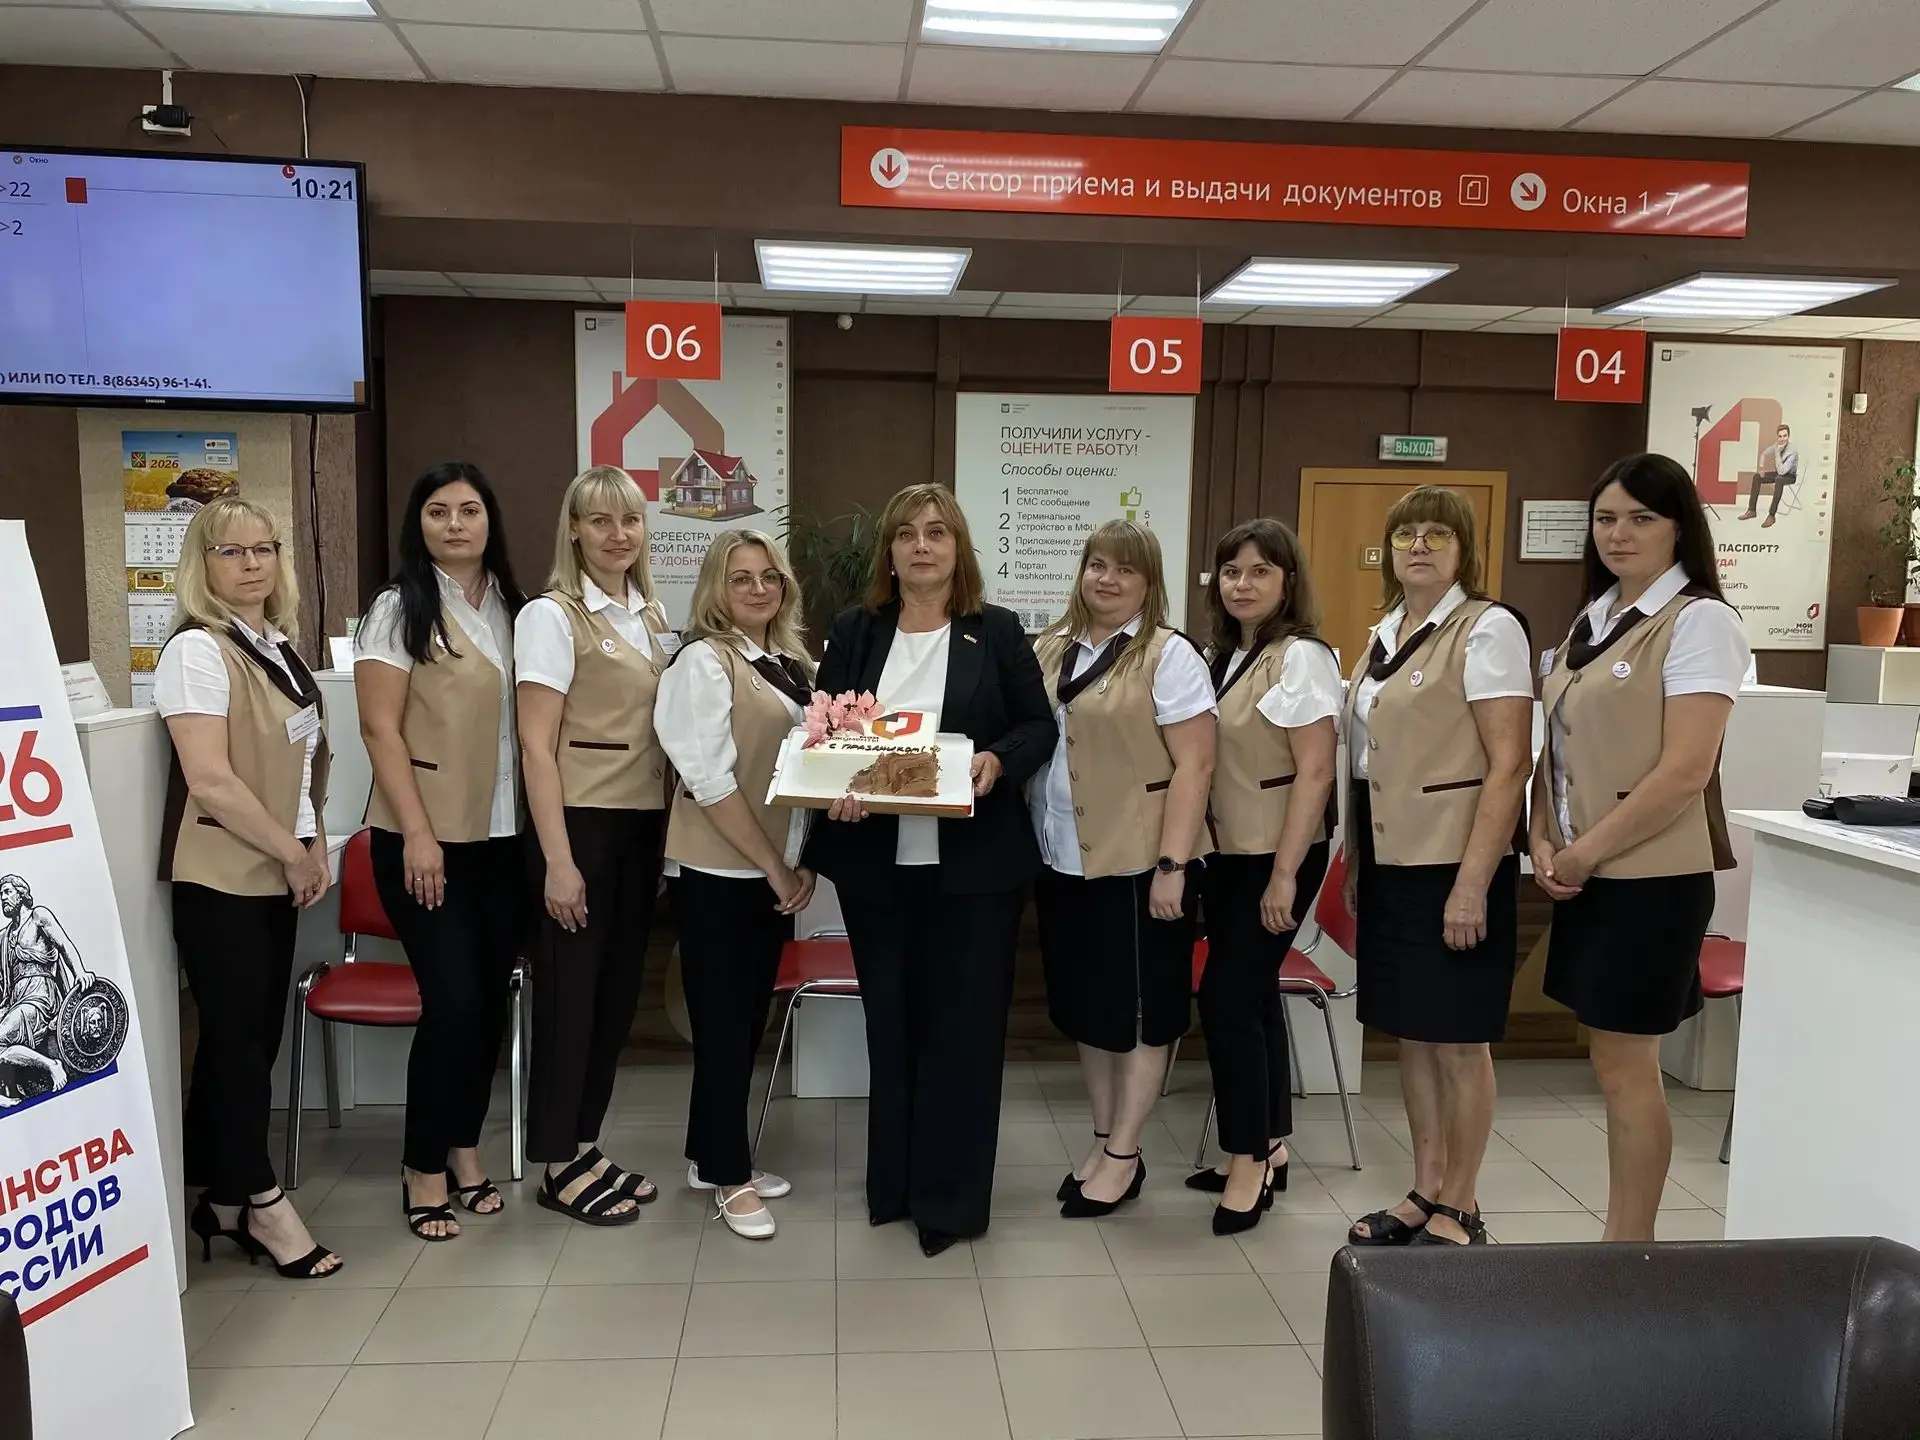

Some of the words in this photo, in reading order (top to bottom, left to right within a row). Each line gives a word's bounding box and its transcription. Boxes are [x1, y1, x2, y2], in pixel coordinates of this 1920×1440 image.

[28, 156, 49, 164] Окно
[291, 178, 354, 201] 10:21
[928, 163, 1022, 198] Сектор
[1033, 171, 1135, 200] приема
[1145, 179, 1160, 198] и
[1171, 179, 1271, 203] выдачи
[1283, 183, 1442, 209] документов
[1562, 187, 1628, 215] Окна
[1638, 190, 1680, 217] 1-7
[645, 323, 702, 362] 06
[1129, 338, 1183, 375] 05
[1575, 349, 1626, 385] 04
[8, 372, 42, 384] ИЛИ
[44, 374, 67, 385] ПО
[68, 374, 101, 387] ТЕЛ.
[103, 375, 161, 390] 8(86345)
[163, 377, 212, 389] 96-1-41.
[1001, 426, 1083, 440] ПОЛУЧИЛИ
[1086, 428, 1142, 441] УСЛУГУ
[1000, 441, 1072, 456] ОЦЕНИТЕ
[1076, 443, 1139, 456] РАБОТУ!
[1395, 439, 1435, 457] ВЫХОД
[150, 459, 180, 469] 2026
[1001, 462, 1063, 476] Способы
[1066, 466, 1118, 478] оценки:
[1001, 487, 1009, 505] 1
[1017, 486, 1069, 496] Бесплатное
[1016, 497, 1038, 506] СМС
[1041, 498, 1090, 508] сообщение
[998, 512, 1011, 530] 2
[1017, 511, 1081, 522] Терминальное
[1144, 510, 1151, 519] 5
[1016, 523, 1066, 533] устройство
[1075, 523, 1097, 531] МФЦ
[648, 543, 674, 553] ВОЙ
[998, 536, 1010, 554] 3
[1015, 536, 1071, 546] Приложение
[1717, 543, 1780, 553] ПАСПОРТ?
[1015, 548, 1068, 557] мобильного
[997, 561, 1009, 579] 4
[1014, 560, 1047, 571] Портал
[1014, 571, 1074, 581] vashkontrol.ru
[0, 730, 63, 821] 6
